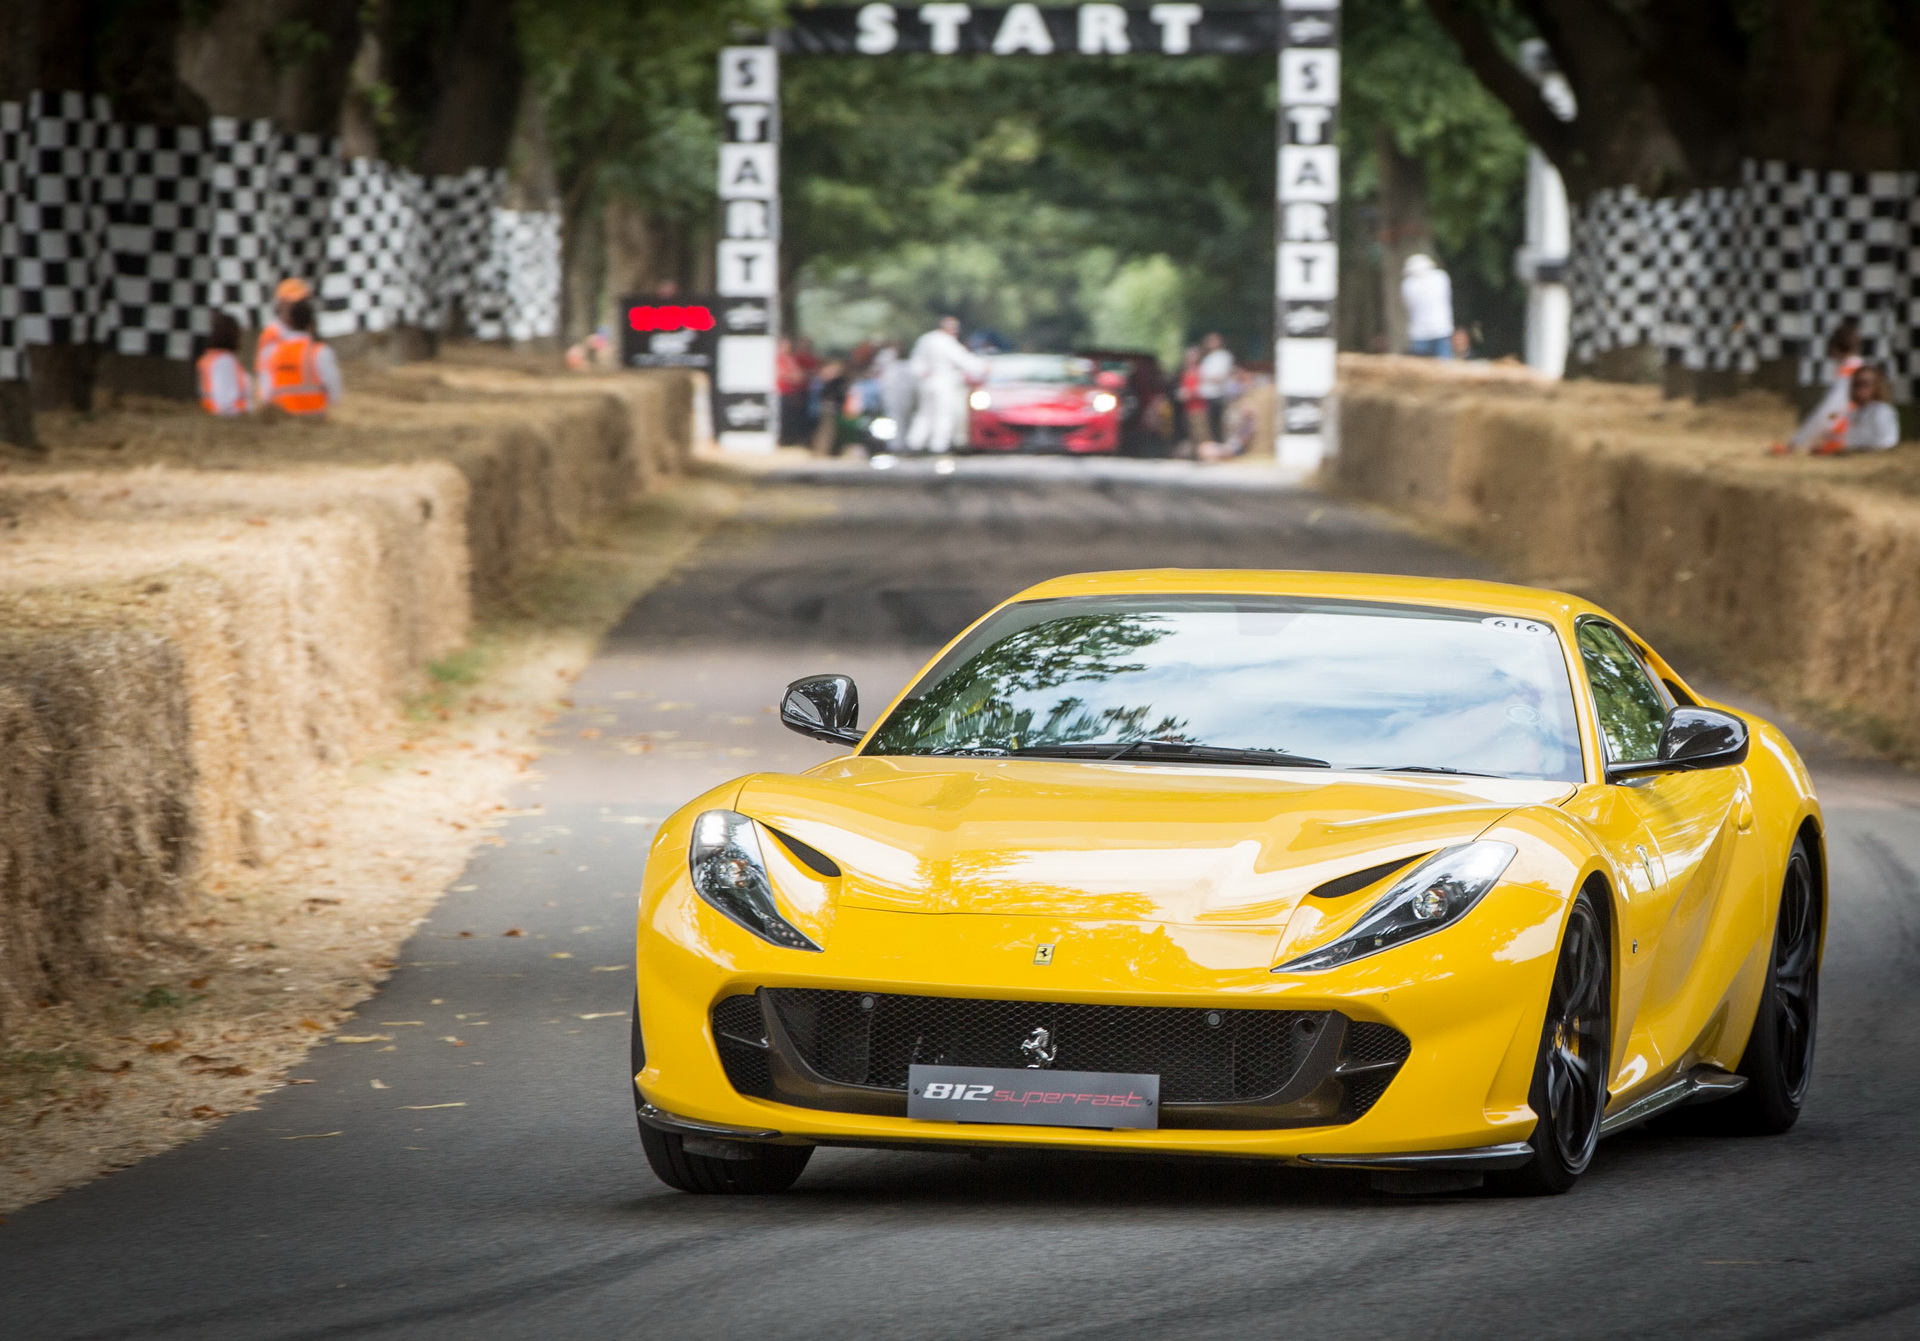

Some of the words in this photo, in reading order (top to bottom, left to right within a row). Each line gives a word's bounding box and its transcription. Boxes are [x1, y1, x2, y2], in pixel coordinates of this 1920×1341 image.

[856, 3, 1203, 54] START
[727, 59, 768, 281] START
[1286, 62, 1332, 283] START
[1494, 620, 1539, 632] 616
[923, 1083, 994, 1101] 812
